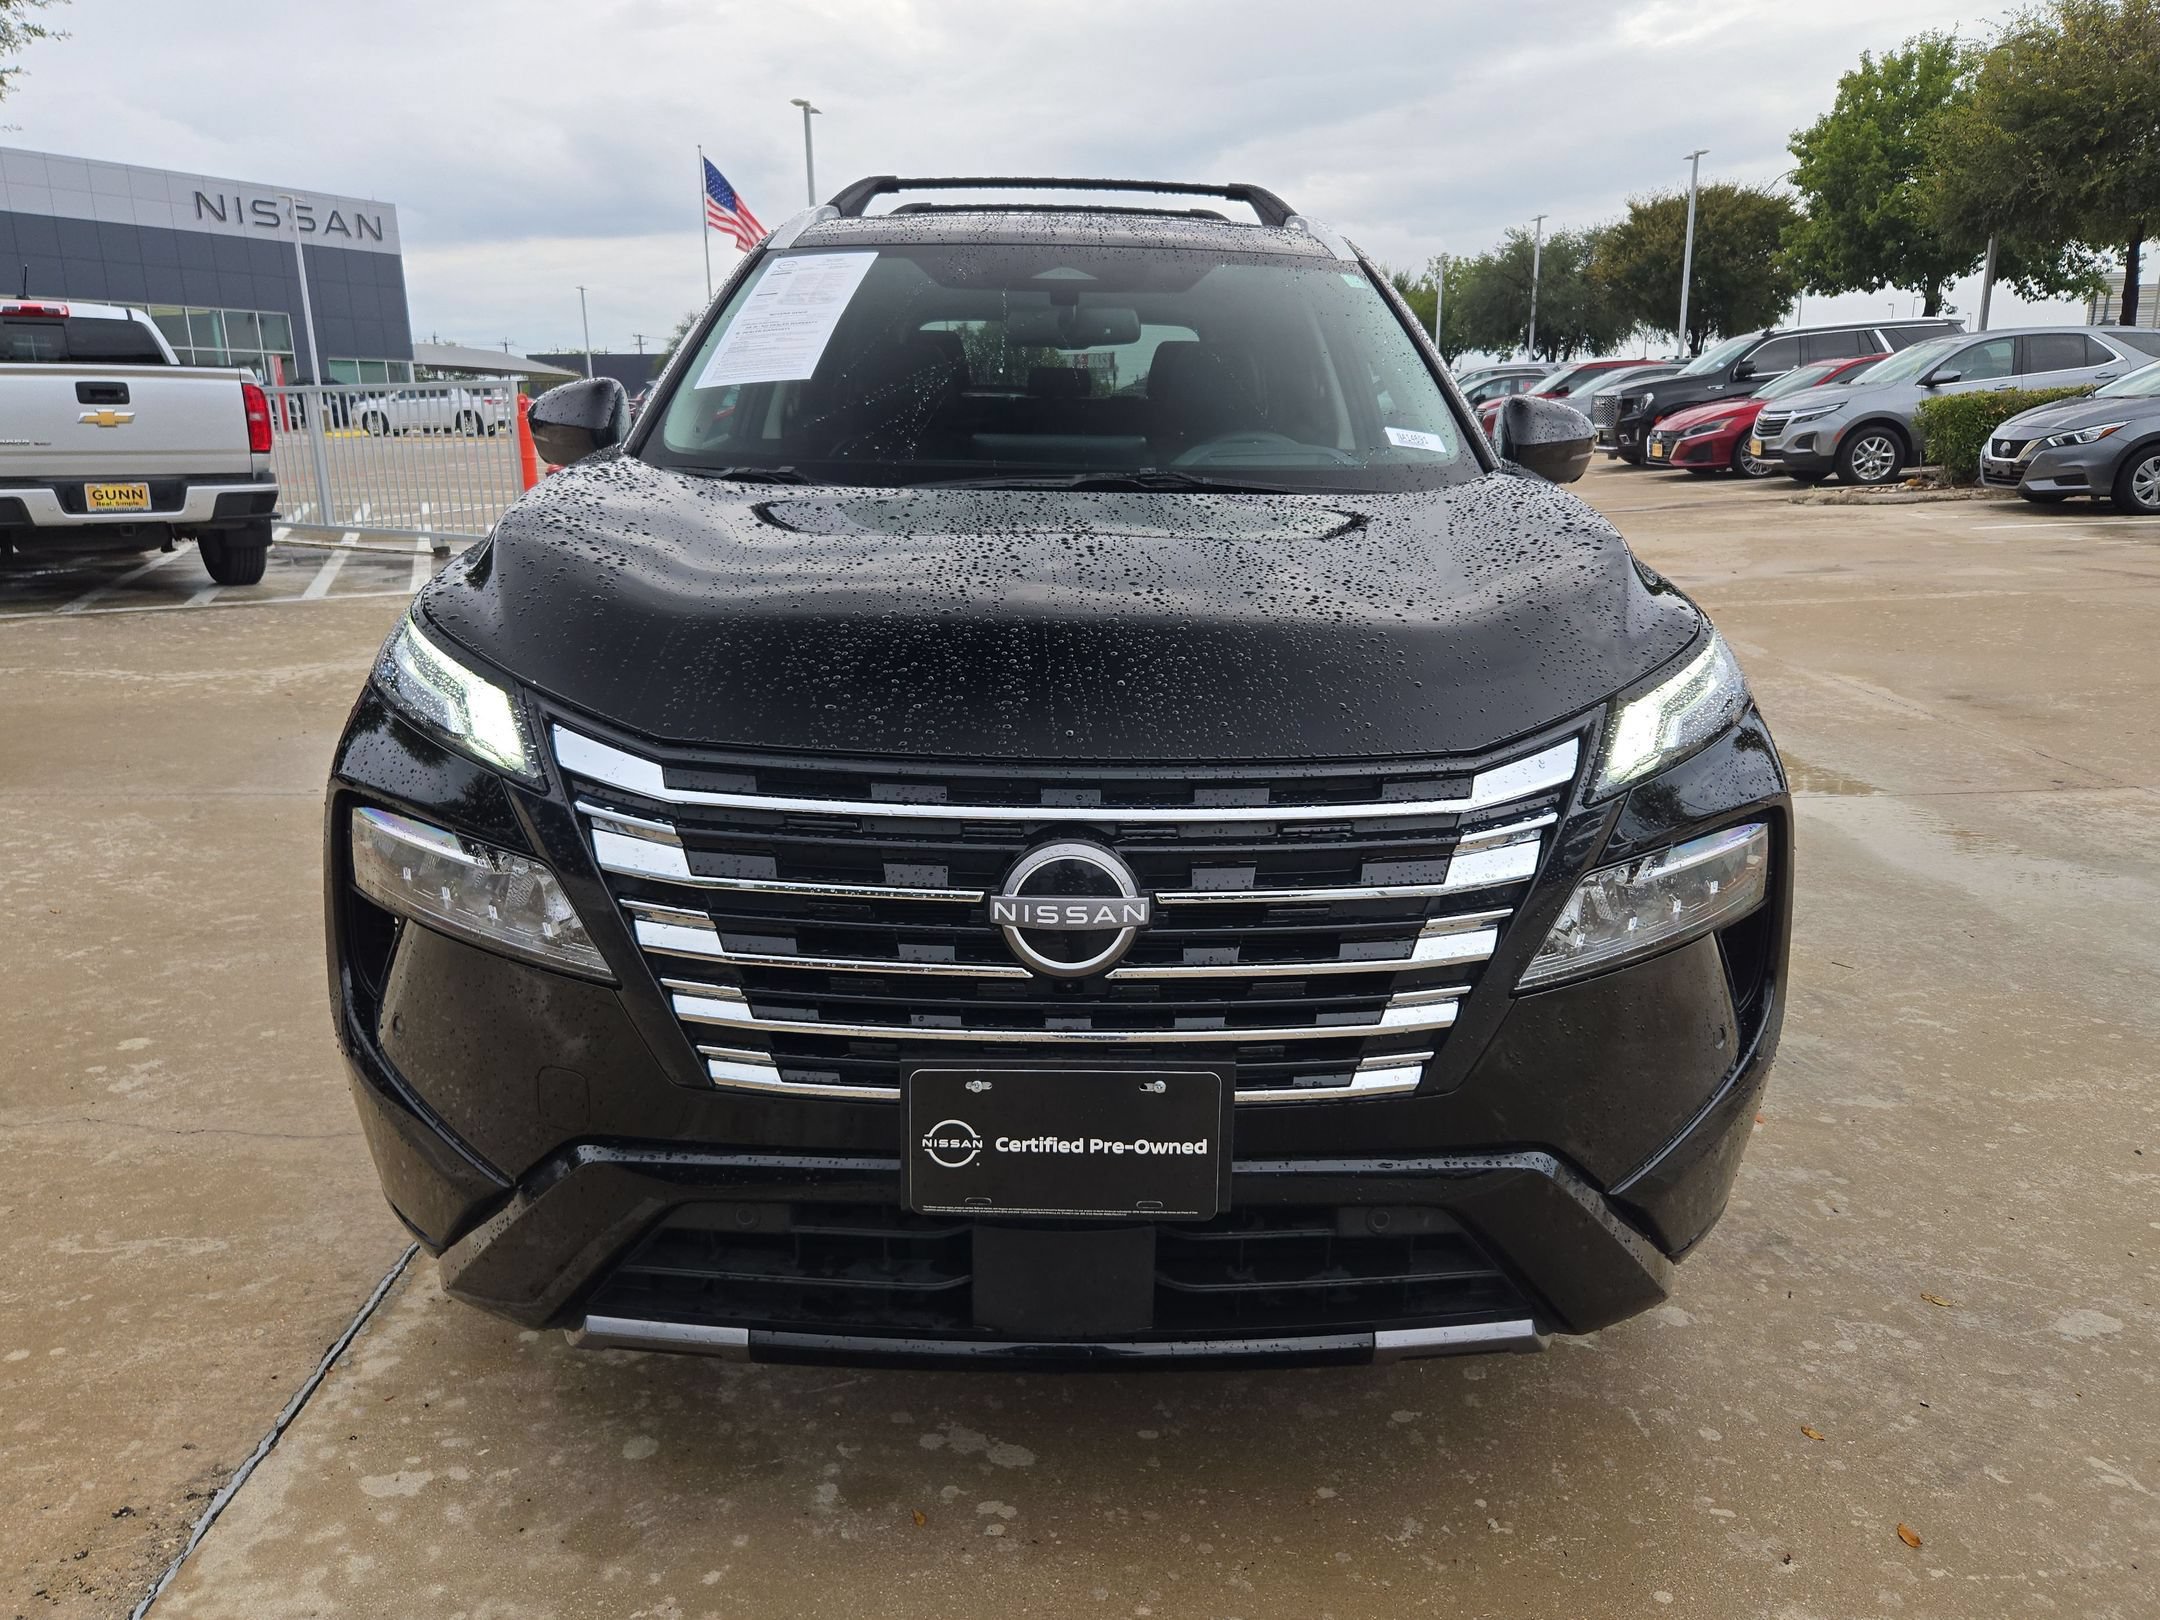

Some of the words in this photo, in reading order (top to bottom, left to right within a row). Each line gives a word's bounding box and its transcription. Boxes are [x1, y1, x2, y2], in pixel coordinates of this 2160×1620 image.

[193, 191, 384, 242] NISSAN
[92, 489, 144, 501] GUNN
[993, 901, 1145, 925] NISSAN
[922, 1138, 983, 1149] NISSAN
[995, 1136, 1084, 1154] Certified
[1089, 1138, 1208, 1155] Pre-Owned
